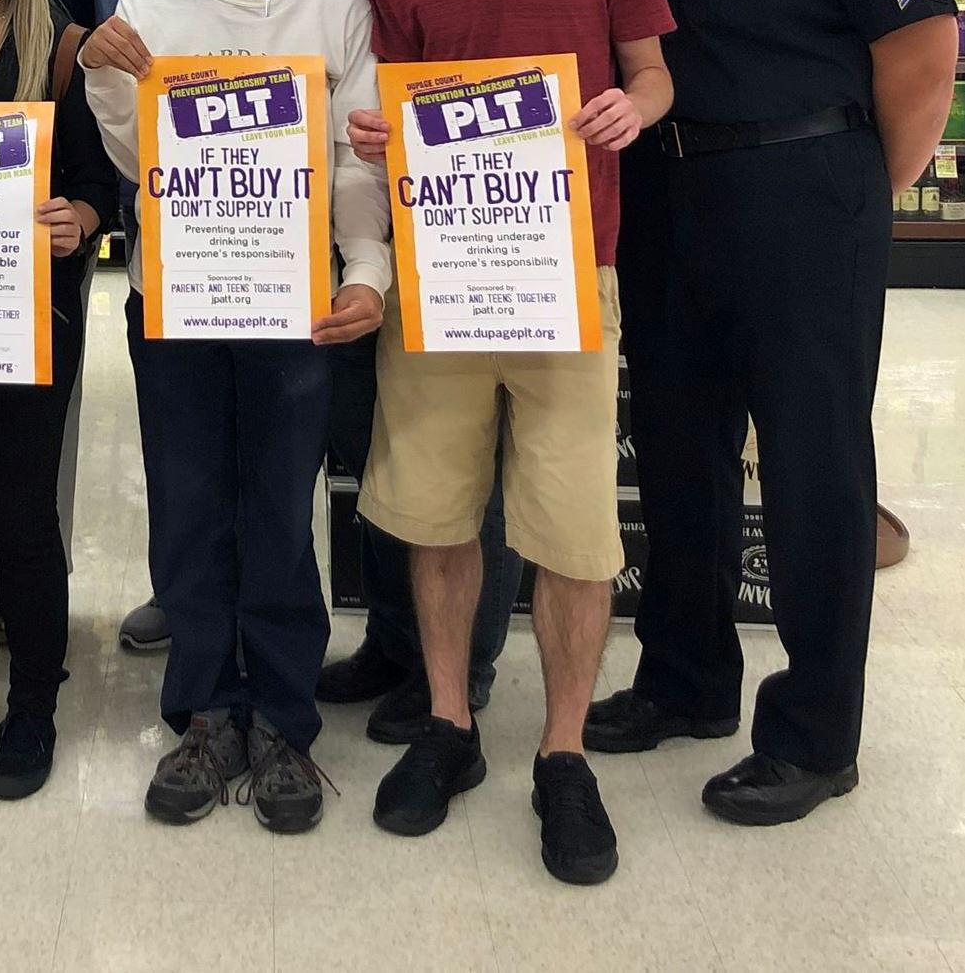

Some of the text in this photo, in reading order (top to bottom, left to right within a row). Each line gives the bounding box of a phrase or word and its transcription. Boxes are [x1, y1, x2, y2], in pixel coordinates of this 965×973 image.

[164, 70, 218, 84] DUPAGE COUNTY
[406, 75, 463, 91] DUPAGE COUNTY
[172, 74, 290, 98] PREVENTION LEADERSHIP TEAM
[415, 74, 541, 105] PREVENTION LEADERSHIP TEAM
[195, 87, 272, 133] PLT
[442, 90, 523, 140] PLT
[241, 132, 263, 142] LEAVE
[265, 130, 284, 139] YOUR
[200, 148, 259, 165] IF THEY
[451, 152, 514, 172] IF THEY
[148, 167, 315, 199] CAN'T BUY IT
[398, 169, 574, 208] CAN'T BUY IT
[171, 200, 292, 218] DON'T SUPPLY IT
[424, 205, 553, 227] DON'T SUPPLY IT
[185, 225, 284, 236] Preventing underage
[210, 236, 260, 247] drinking is
[440, 232, 545, 244] Preventing underage
[176, 249, 295, 260] everyone's responsibility
[467, 245, 520, 256] drinking is
[432, 257, 559, 269] everyone's responsibility
[171, 283, 291, 294] PARENTS AND TEENS TOGETHER
[211, 294, 251, 305] jpatt.org
[429, 294, 557, 305] PARENTS AND TEENS TOGETHER
[473, 305, 515, 316] jpatt.org
[183, 315, 288, 328] www.dupageplt.org
[444, 327, 556, 341] www.dupageplt.org
